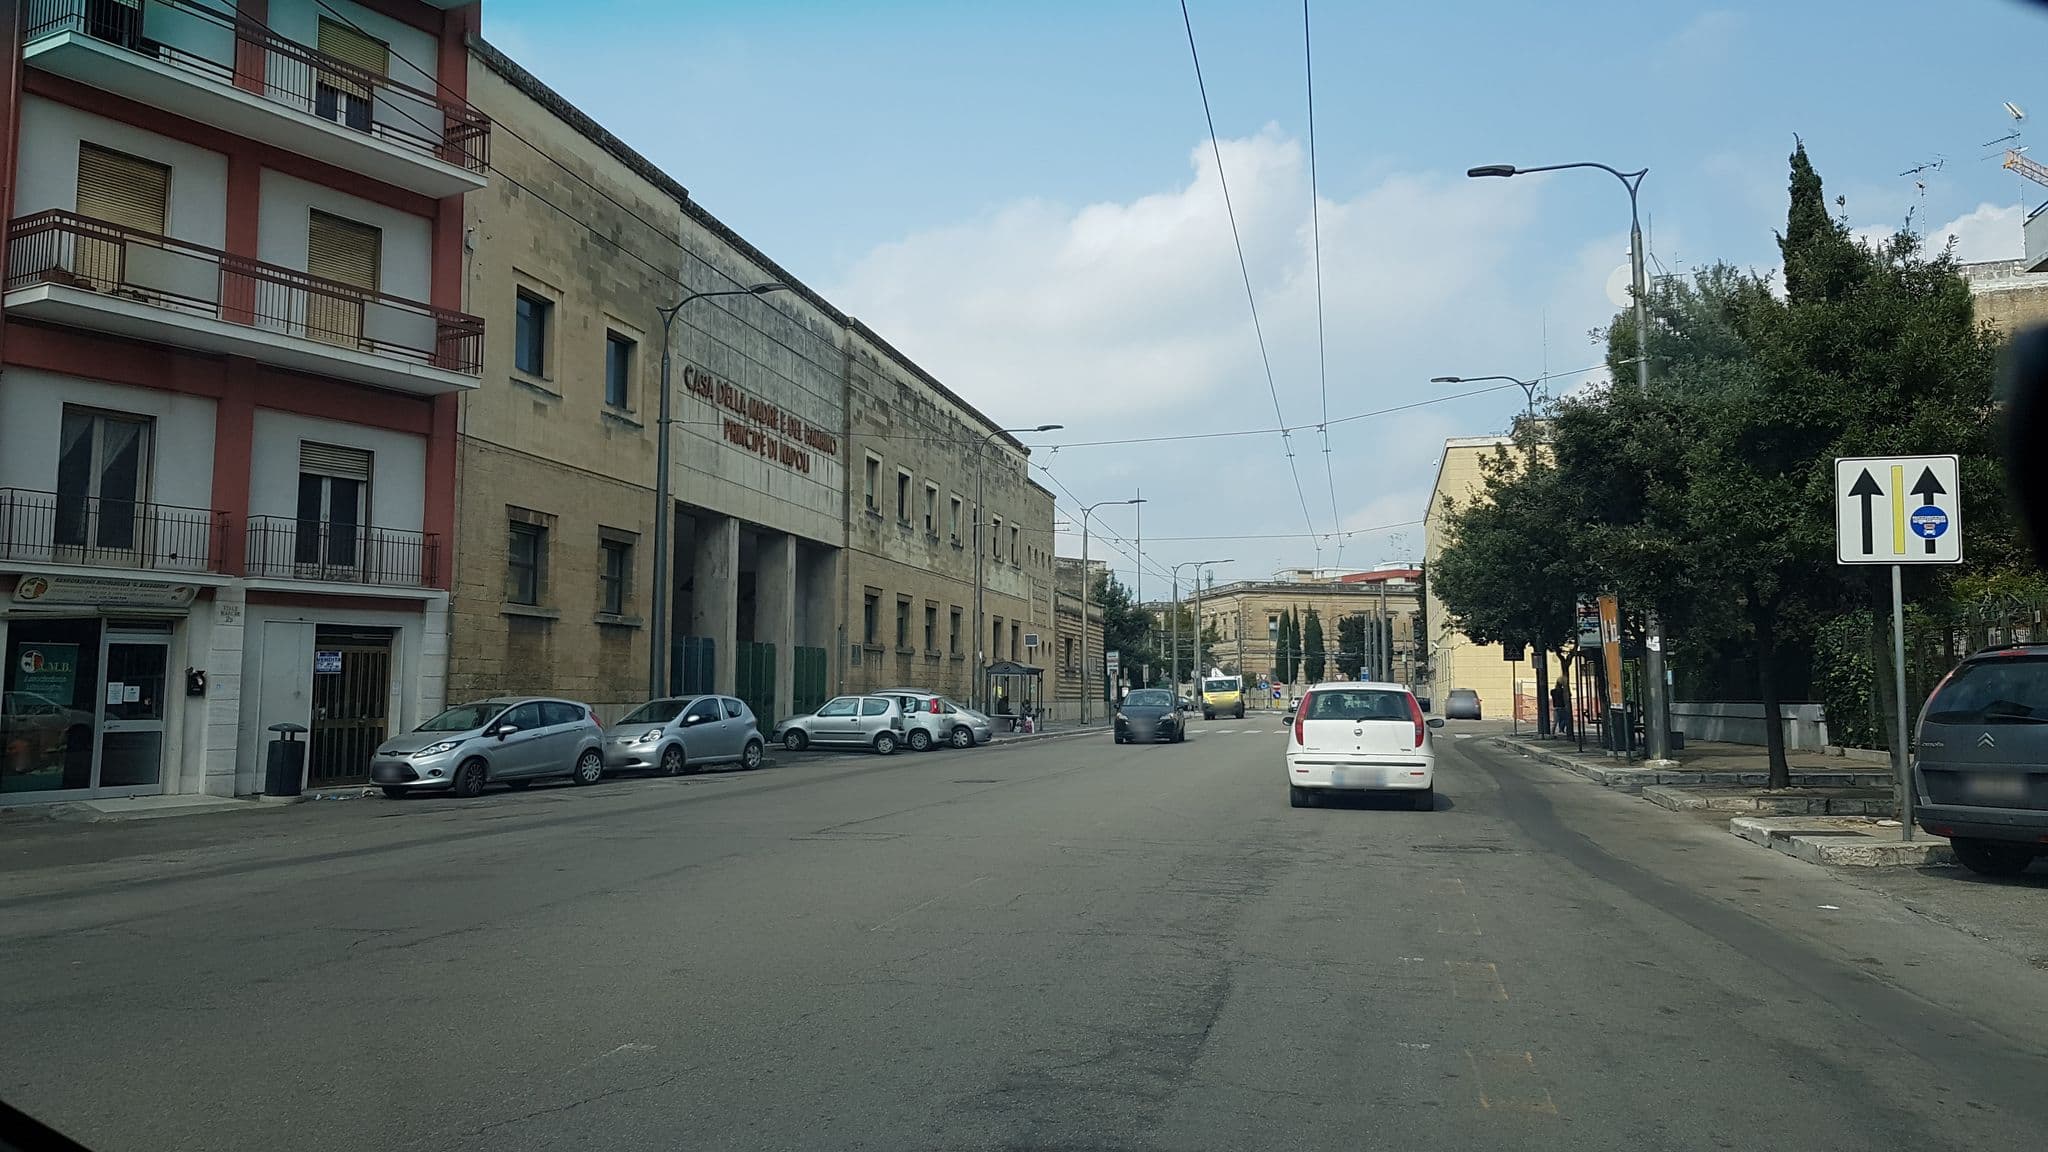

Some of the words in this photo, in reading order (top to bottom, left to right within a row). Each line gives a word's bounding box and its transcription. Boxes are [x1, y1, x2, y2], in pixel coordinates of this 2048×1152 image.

[684, 364, 713, 399] CASA
[716, 380, 746, 416] DELLA
[748, 397, 779, 431] MADRE
[780, 411, 787, 433] E
[788, 414, 803, 441] DEL
[804, 423, 837, 456] BAMBINO
[723, 417, 766, 456] PRINCIPE
[768, 436, 778, 461] DI
[780, 442, 810, 474] NAPOLI
